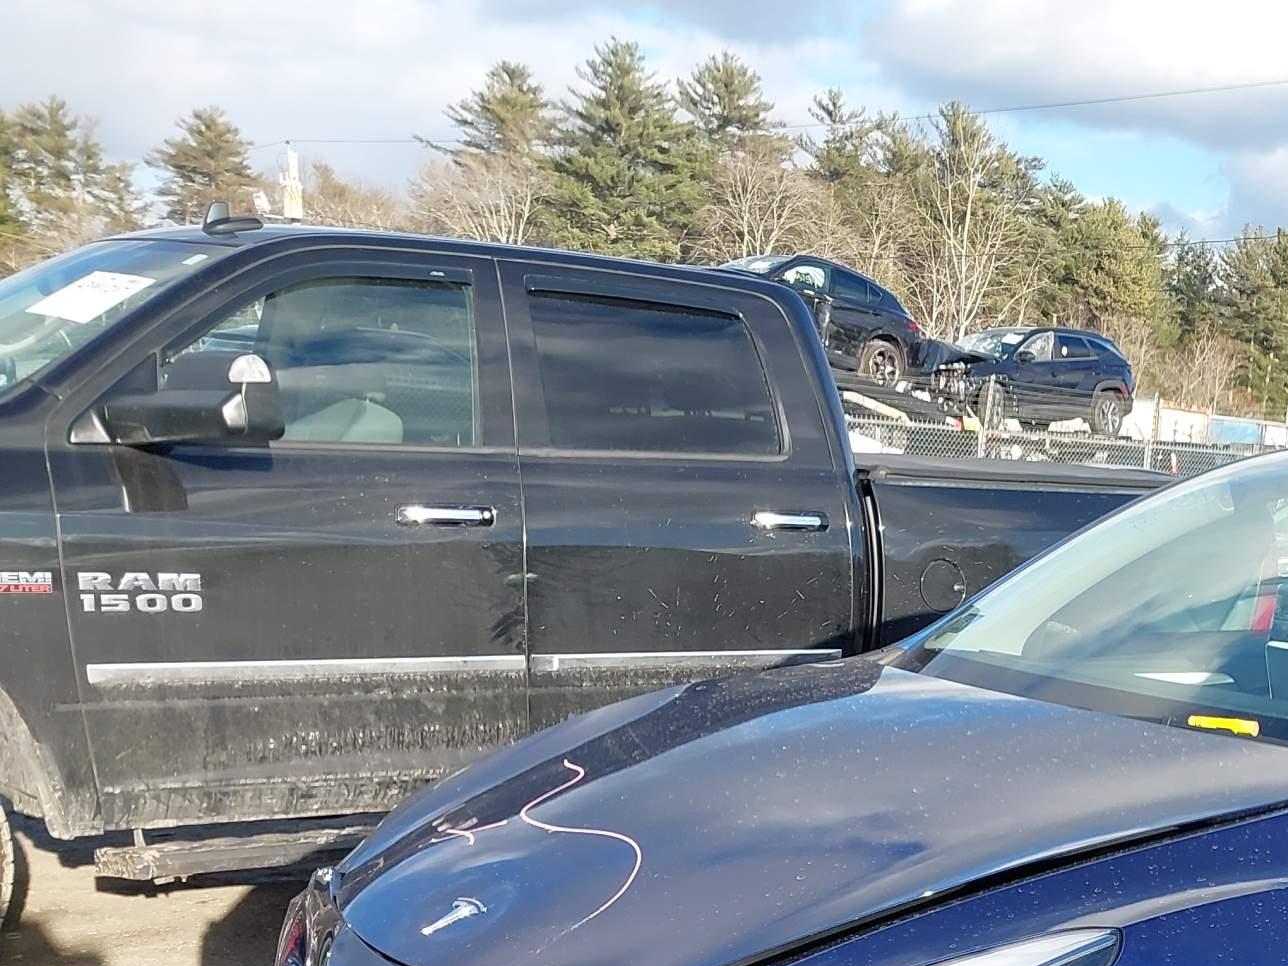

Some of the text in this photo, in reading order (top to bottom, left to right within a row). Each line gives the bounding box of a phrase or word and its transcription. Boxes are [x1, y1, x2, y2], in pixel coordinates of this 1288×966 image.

[0, 571, 52, 584] EMI
[77, 571, 202, 591] RAM
[80, 593, 203, 613] 1500
